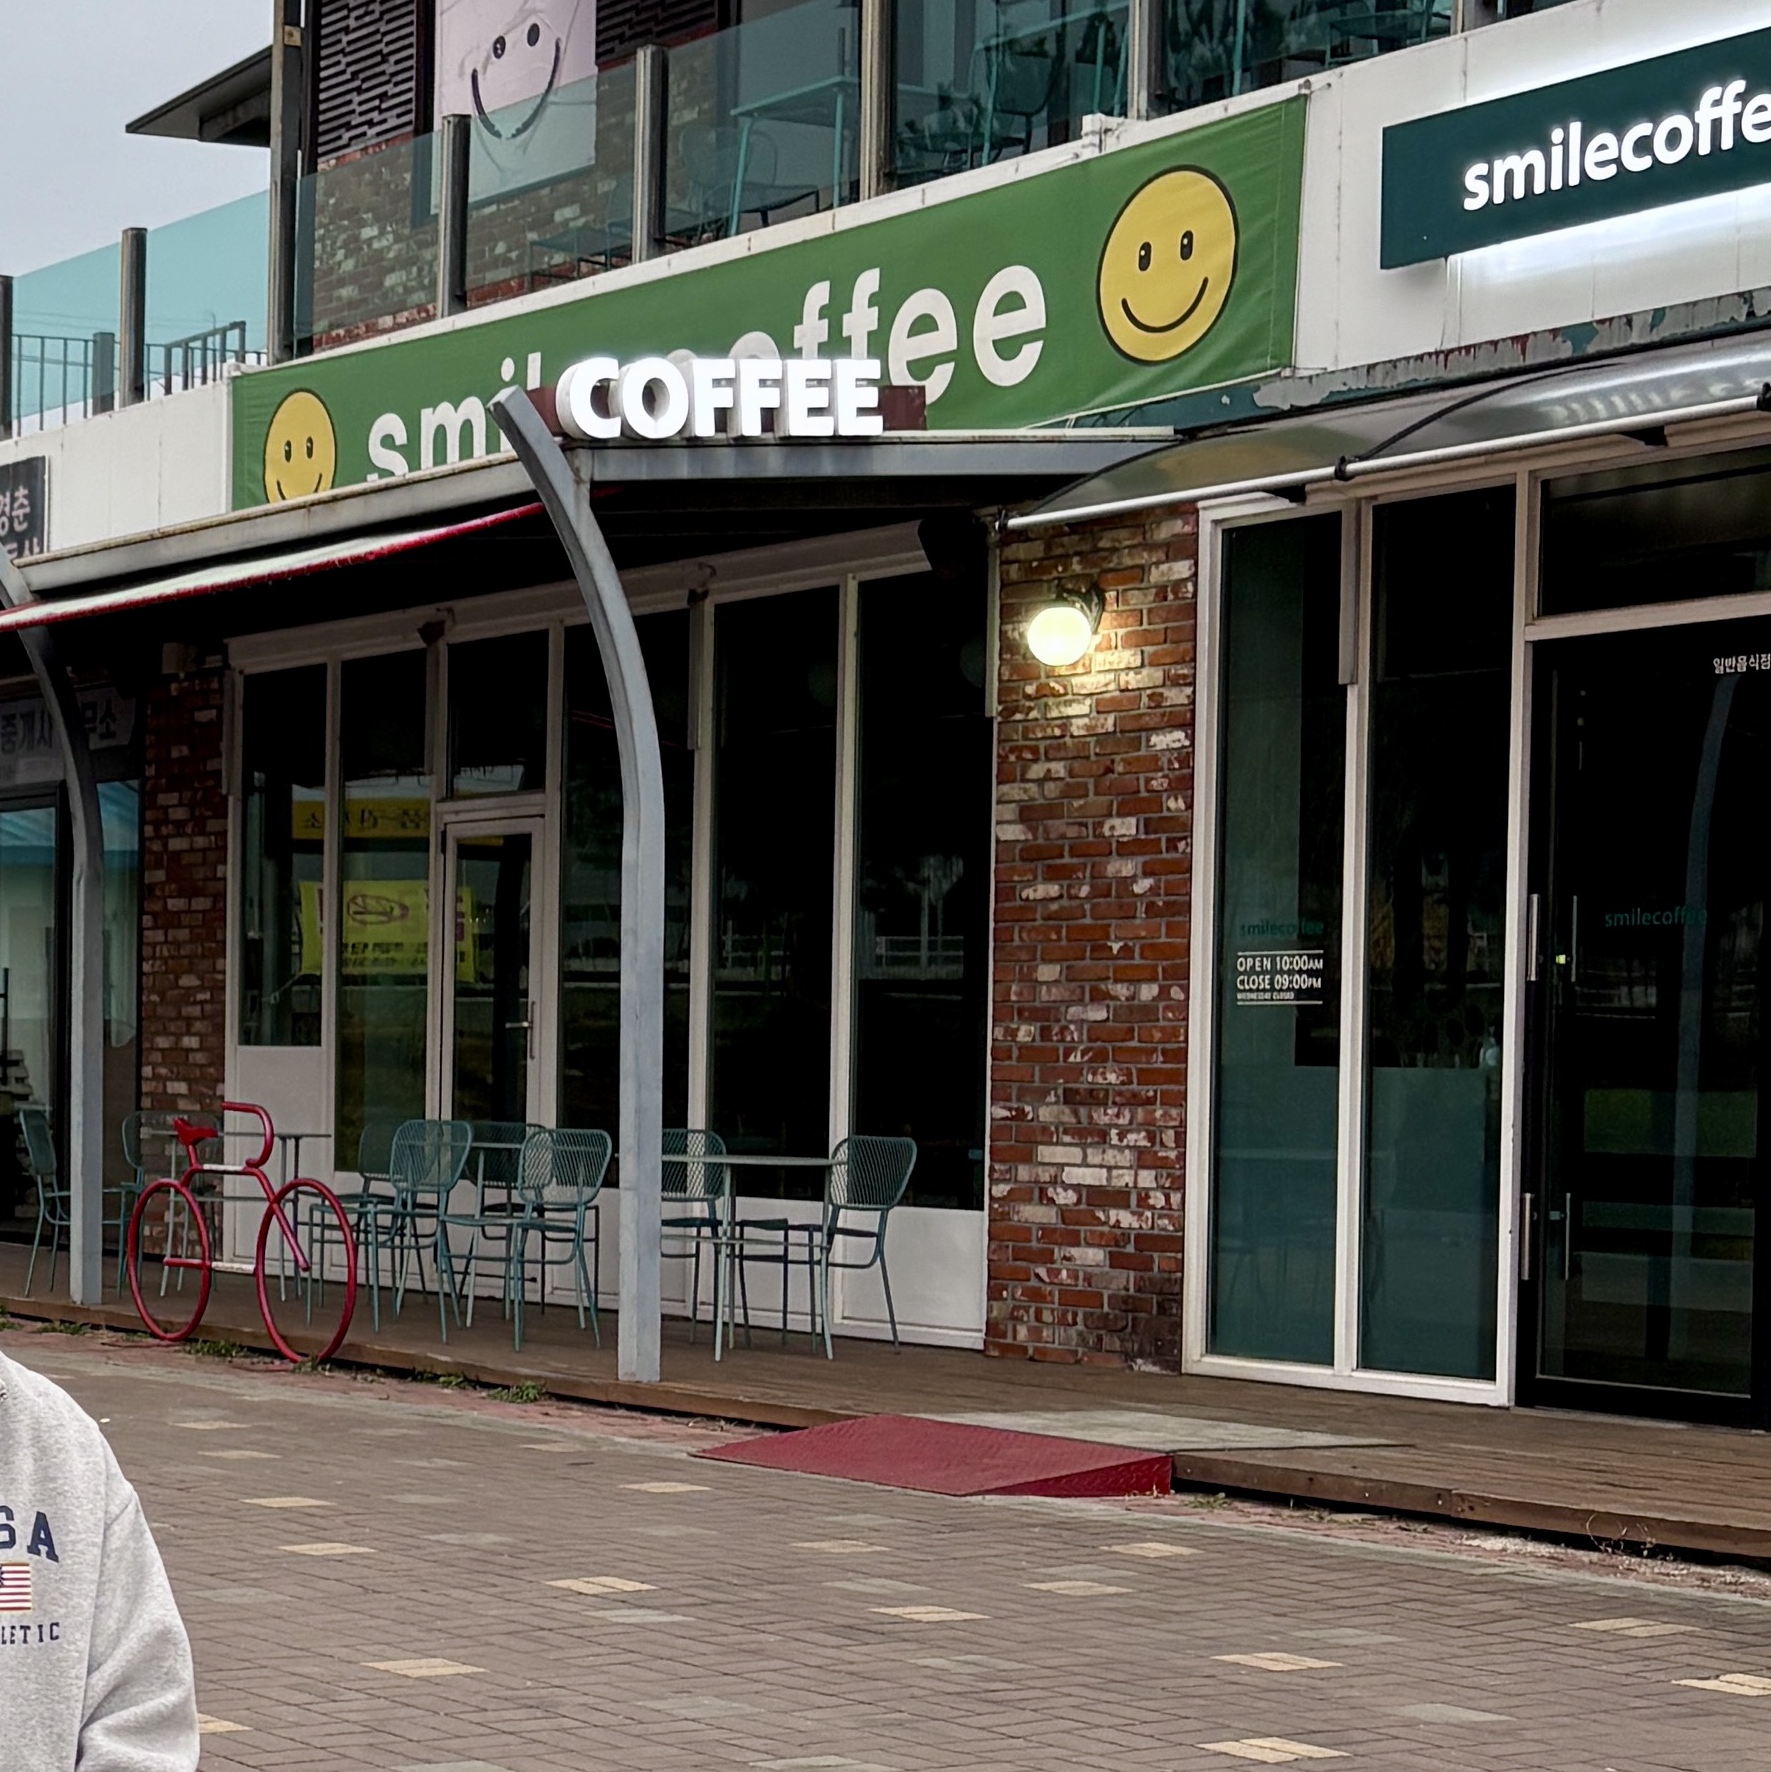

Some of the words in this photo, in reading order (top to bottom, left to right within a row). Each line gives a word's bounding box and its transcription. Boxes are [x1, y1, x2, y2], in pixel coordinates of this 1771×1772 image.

[1462, 79, 1771, 211] smilecoffe
[555, 356, 884, 441] COFFEE
[1712, 652, 1771, 675] 일반음식점
[1236, 956, 1271, 972] OPEN
[1236, 974, 1271, 990] CLOSE
